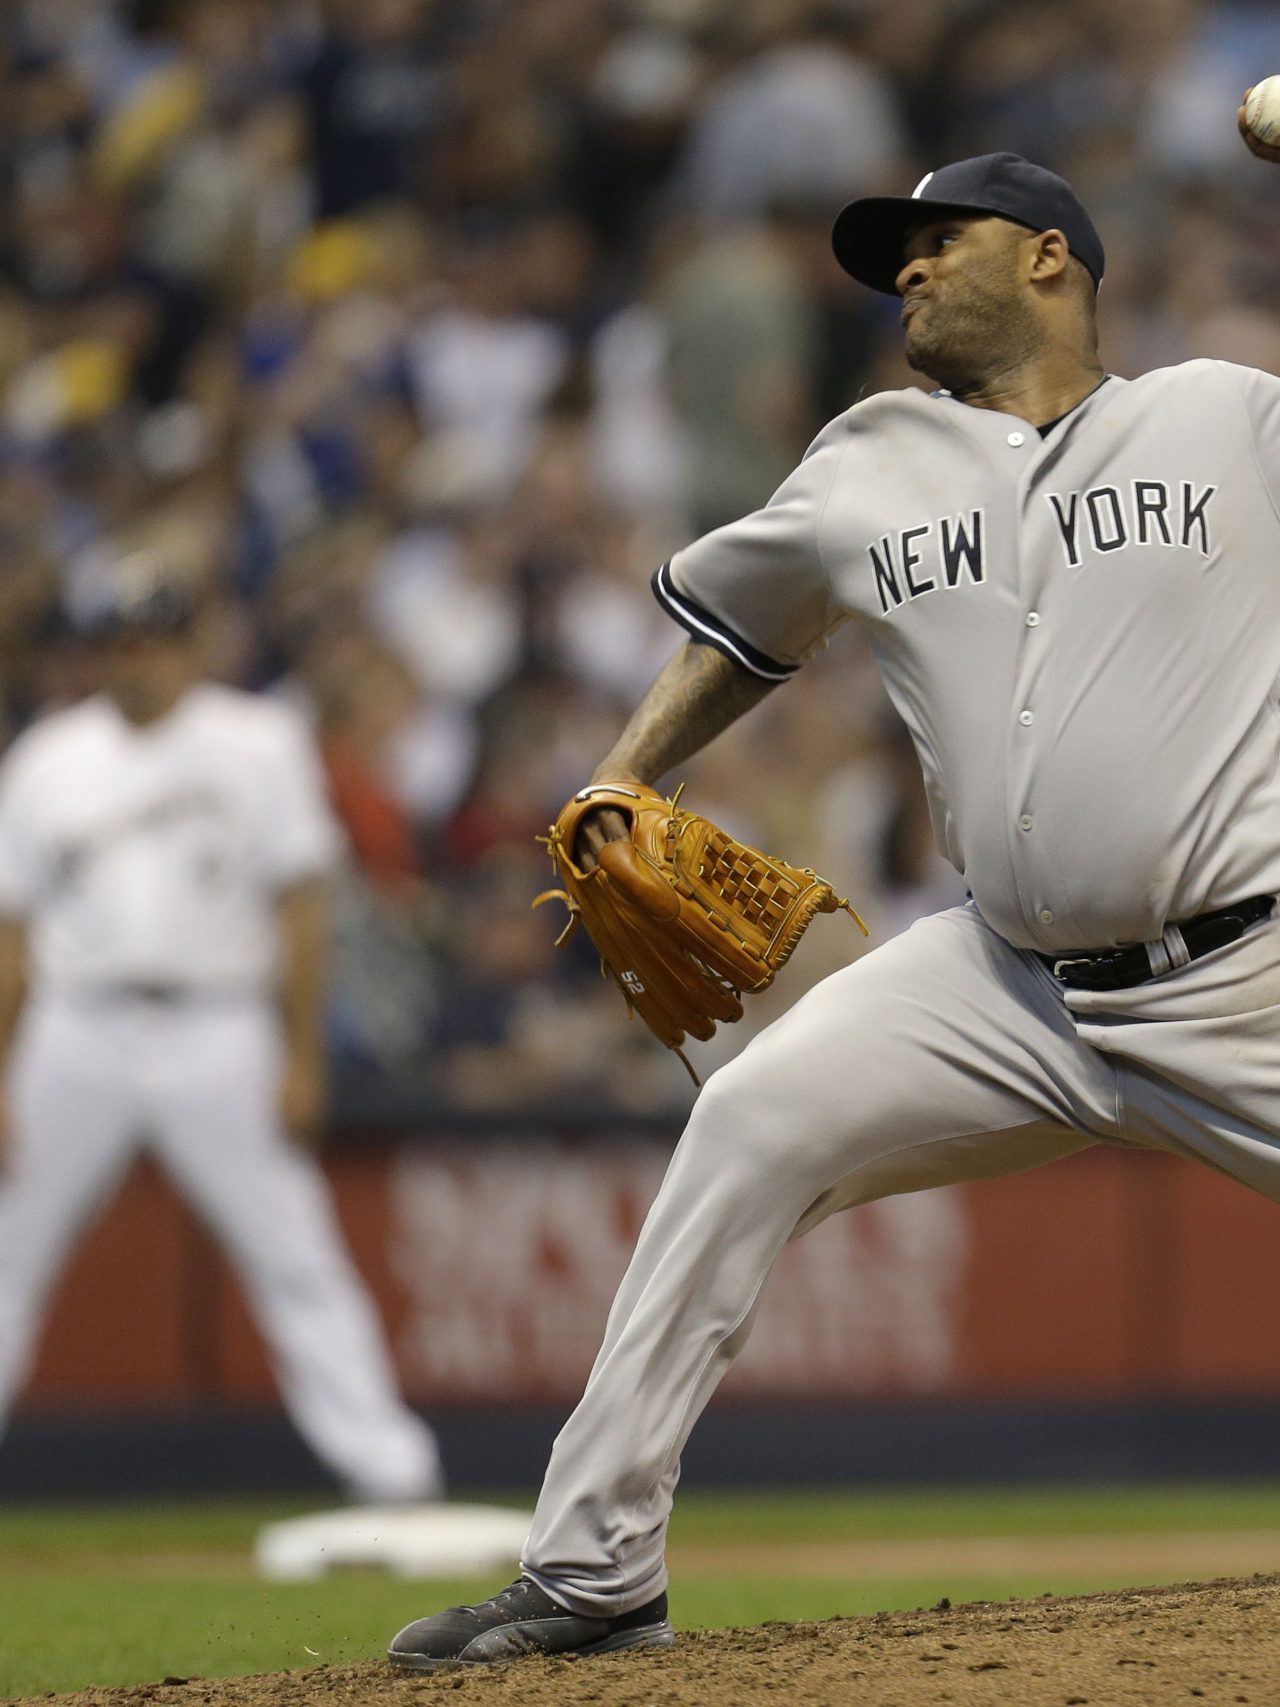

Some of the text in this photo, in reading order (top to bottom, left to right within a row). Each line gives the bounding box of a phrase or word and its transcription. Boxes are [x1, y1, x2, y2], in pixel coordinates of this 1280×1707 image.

[866, 479, 1219, 616] NEW YORK
[620, 970, 646, 995] 52
